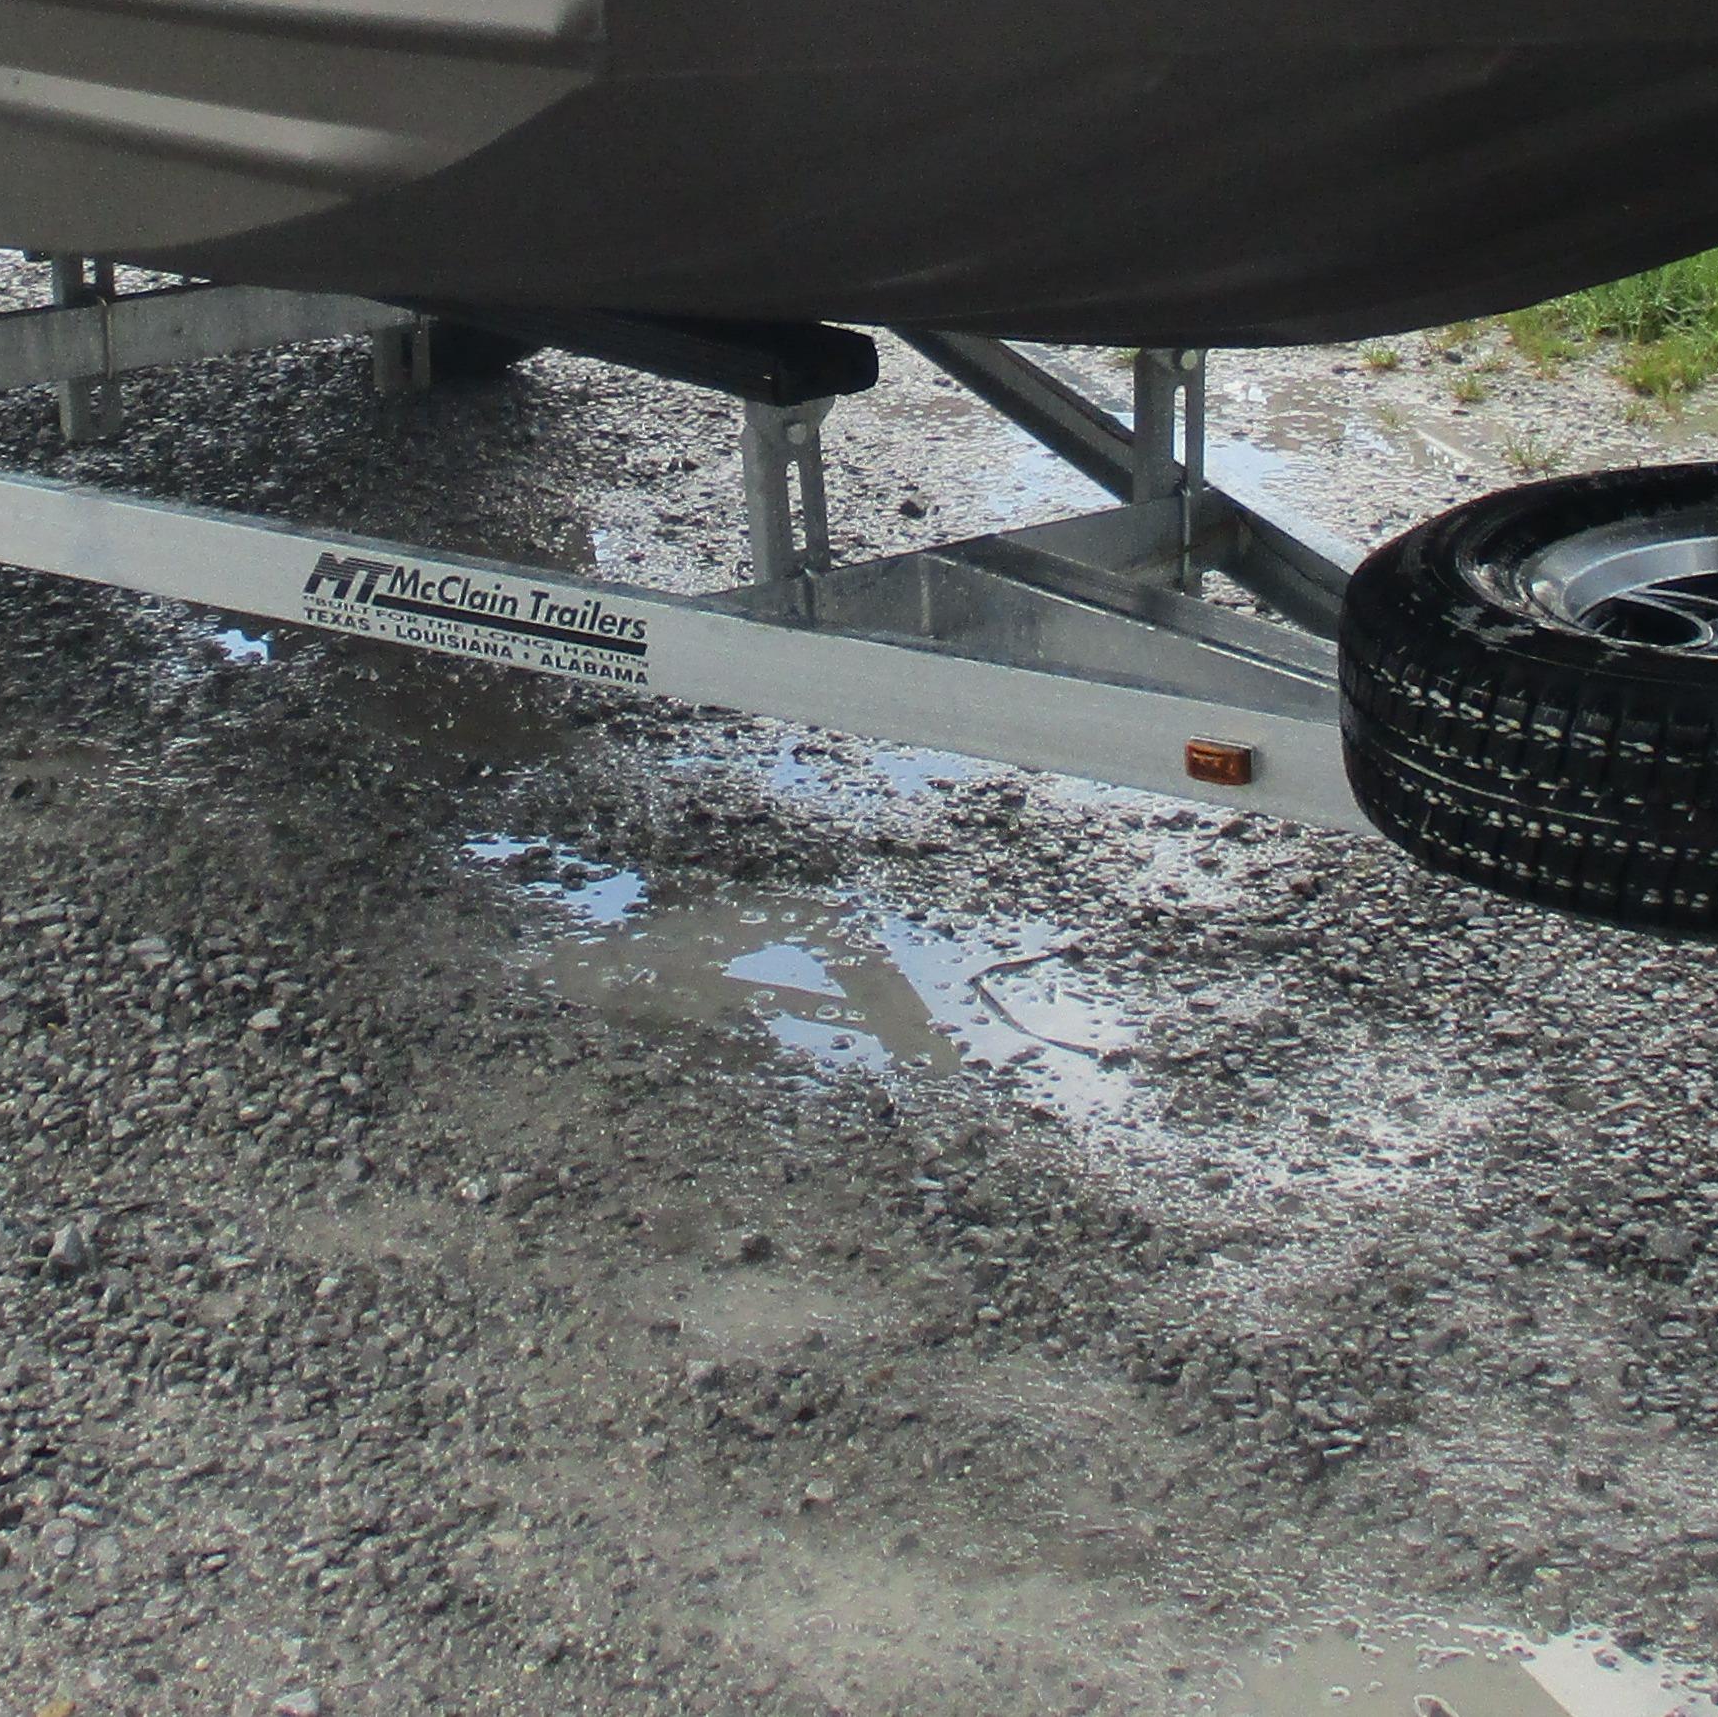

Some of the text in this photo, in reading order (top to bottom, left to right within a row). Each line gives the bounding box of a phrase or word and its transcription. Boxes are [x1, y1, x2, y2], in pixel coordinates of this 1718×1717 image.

[376, 608, 418, 624] FOR
[427, 620, 462, 633] THE
[474, 628, 554, 651] LONG
[388, 566, 518, 617] McClain
[530, 590, 648, 639] Trailers
[303, 607, 649, 686] TEXAS LOUISIANA ALABAMA
